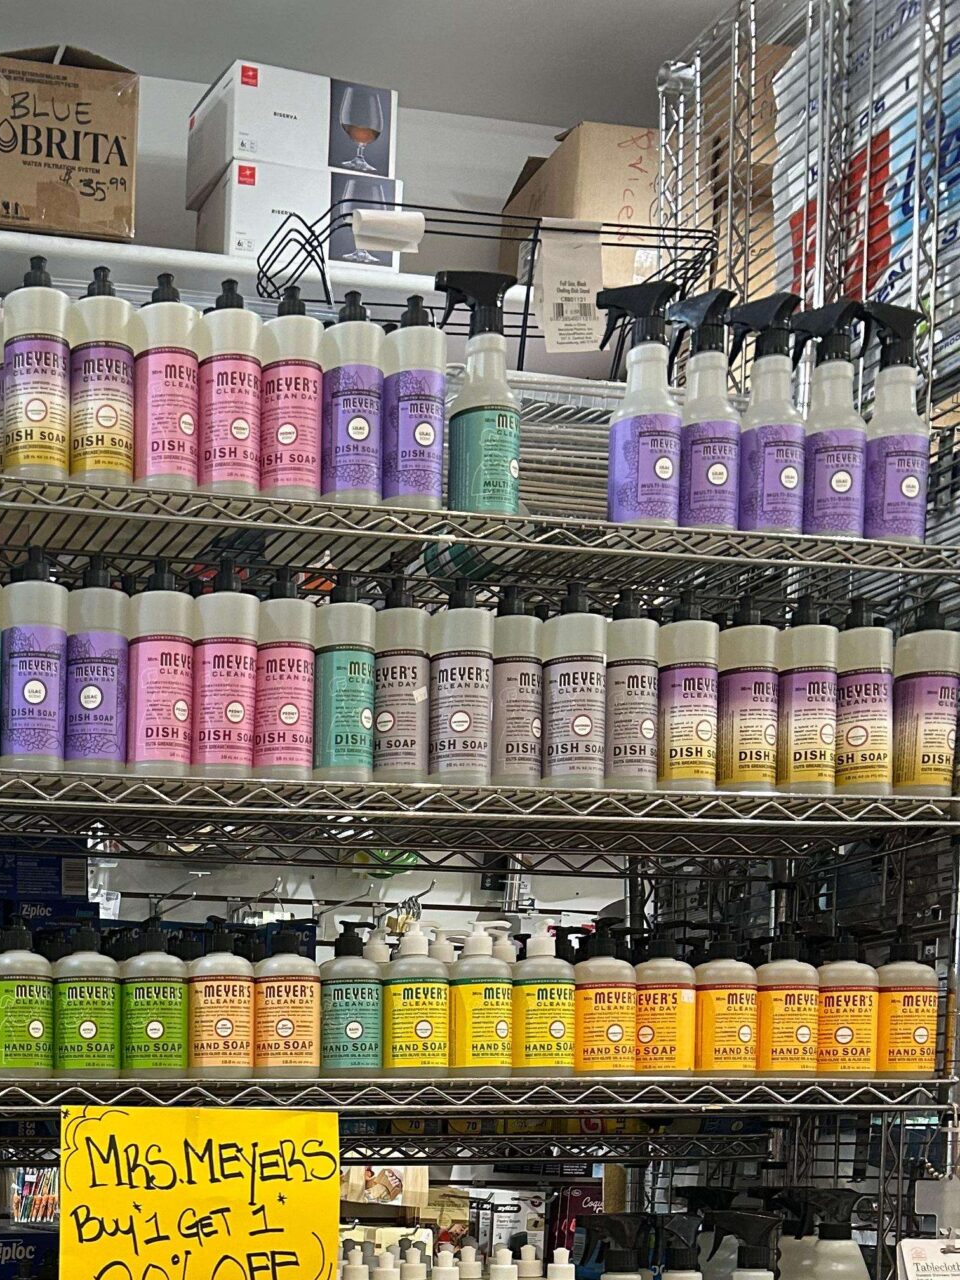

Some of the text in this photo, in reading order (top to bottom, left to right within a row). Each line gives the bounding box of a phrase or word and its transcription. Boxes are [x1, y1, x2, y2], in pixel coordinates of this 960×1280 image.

[9, 91, 92, 125] BLUE
[273, 112, 298, 120] RISERVA
[20, 124, 128, 167] BRITA
[22, 160, 42, 168] WATER
[78, 166, 100, 174] SYSTEM
[13, 351, 67, 371] MEYER'S
[265, 377, 318, 395] MEYER'S
[73, 435, 105, 450] DISH
[151, 441, 185, 452] DISH
[204, 448, 237, 462] DISH
[289, 453, 316, 465] SOAP
[670, 746, 702, 758] DISH
[793, 750, 827, 762] DISH
[67, 984, 116, 999] MEYER'S
[824, 995, 873, 1007] MEYER'S
[222, 1041, 250, 1050] SOAP
[842, 1047, 872, 1056] SOAP
[408, 1120, 420, 1130] 70
[466, 1121, 478, 1130] 70
[85, 1134, 337, 1206] MRS. MEYERS
[70, 1204, 284, 1256] Buy 1 GET 1
